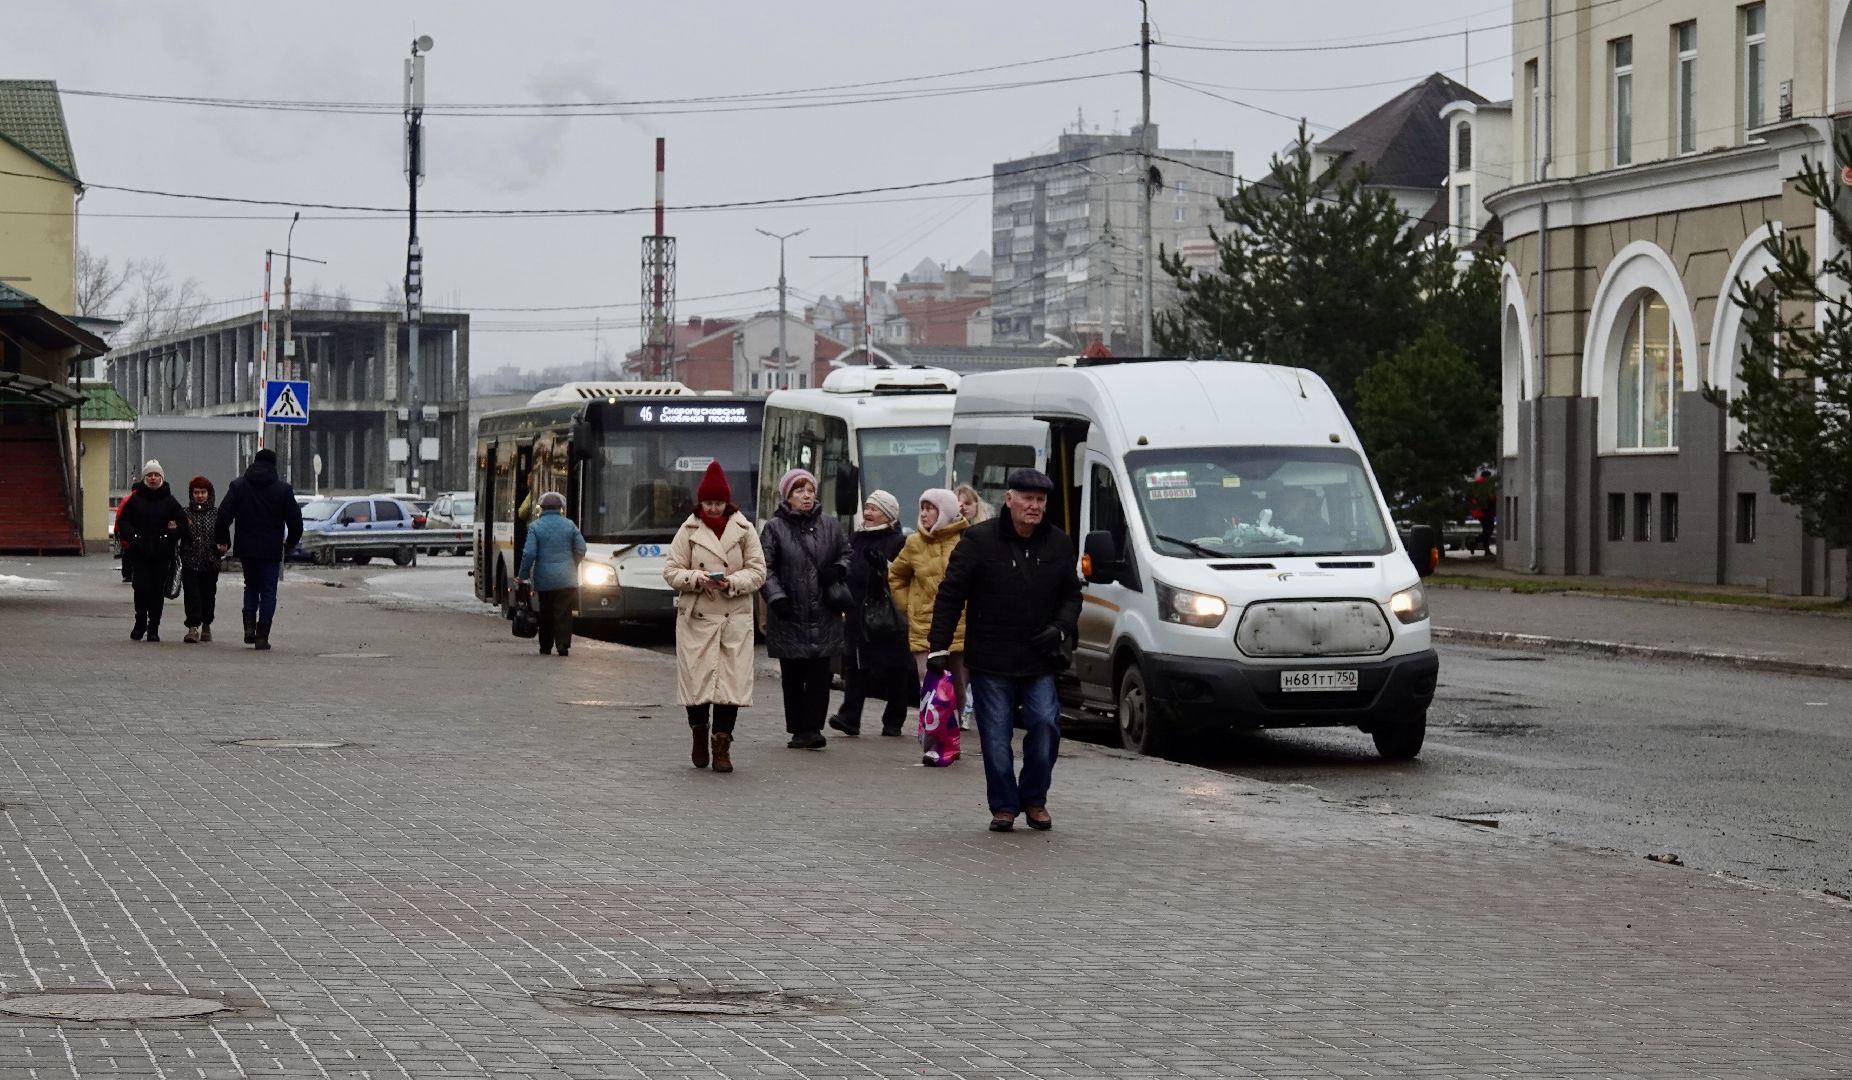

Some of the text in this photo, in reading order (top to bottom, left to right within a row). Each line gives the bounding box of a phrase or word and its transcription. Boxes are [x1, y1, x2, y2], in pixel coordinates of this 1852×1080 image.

[639, 406, 653, 422] 46
[660, 415, 705, 423] Скобяной
[893, 442, 906, 454] 42
